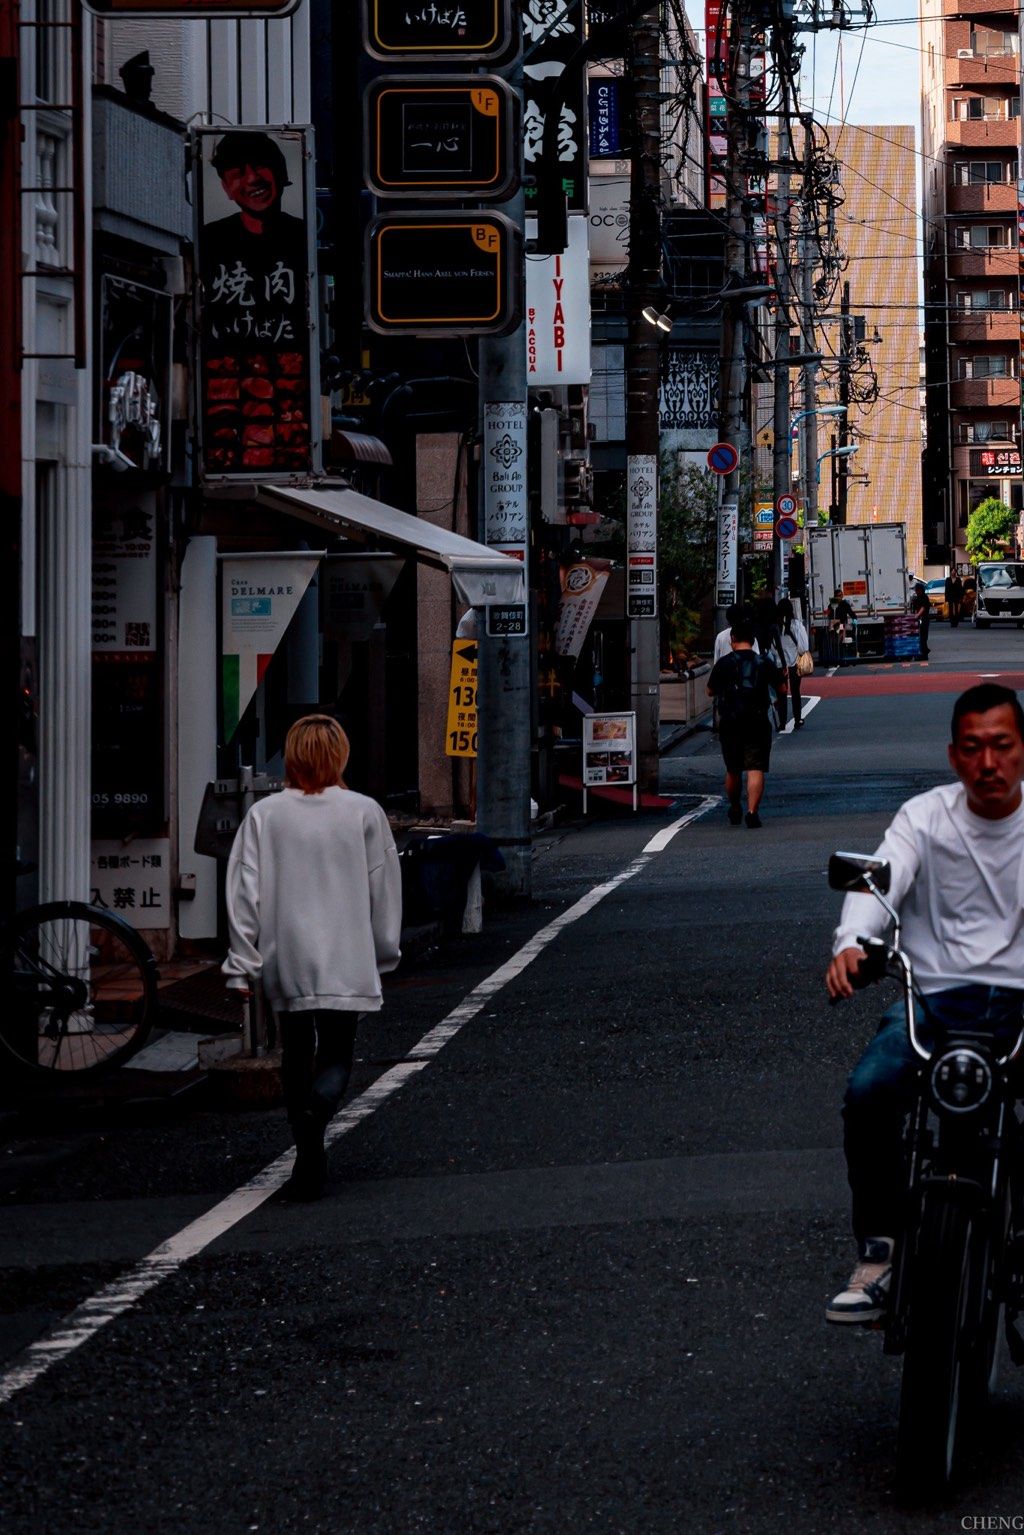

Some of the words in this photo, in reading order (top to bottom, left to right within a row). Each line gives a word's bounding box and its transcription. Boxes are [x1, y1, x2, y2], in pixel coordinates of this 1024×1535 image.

[405, 5, 468, 27] いけばた
[476, 228, 496, 248] BF
[212, 261, 295, 306] 焼肉
[528, 308, 535, 325] BY
[212, 311, 295, 343] いけばた
[528, 328, 536, 373] ACQUA
[488, 421, 523, 430] HOTEL
[490, 484, 523, 494] GROUP
[497, 500, 520, 511] ホテル
[489, 511, 524, 524] バリアン
[231, 585, 294, 596] DELMARE
[116, 793, 148, 804] 9890
